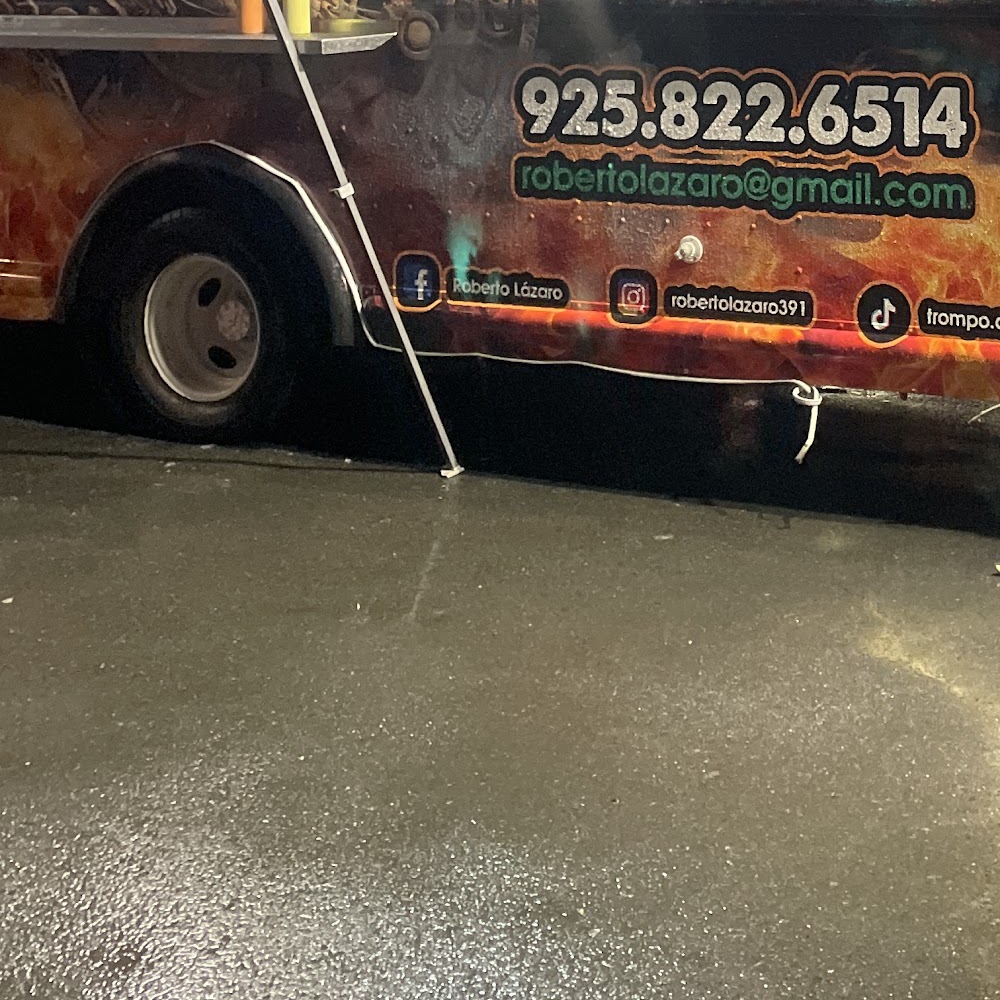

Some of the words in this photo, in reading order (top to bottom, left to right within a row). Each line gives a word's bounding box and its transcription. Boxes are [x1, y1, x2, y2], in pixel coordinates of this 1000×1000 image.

[521, 76, 967, 148] 925.822.6514
[521, 162, 967, 211] robertolazaro@gmail.com
[453, 278, 509, 297] Roberto
[514, 280, 563, 300] Lázaro
[671, 293, 806, 317] robertolazaro391
